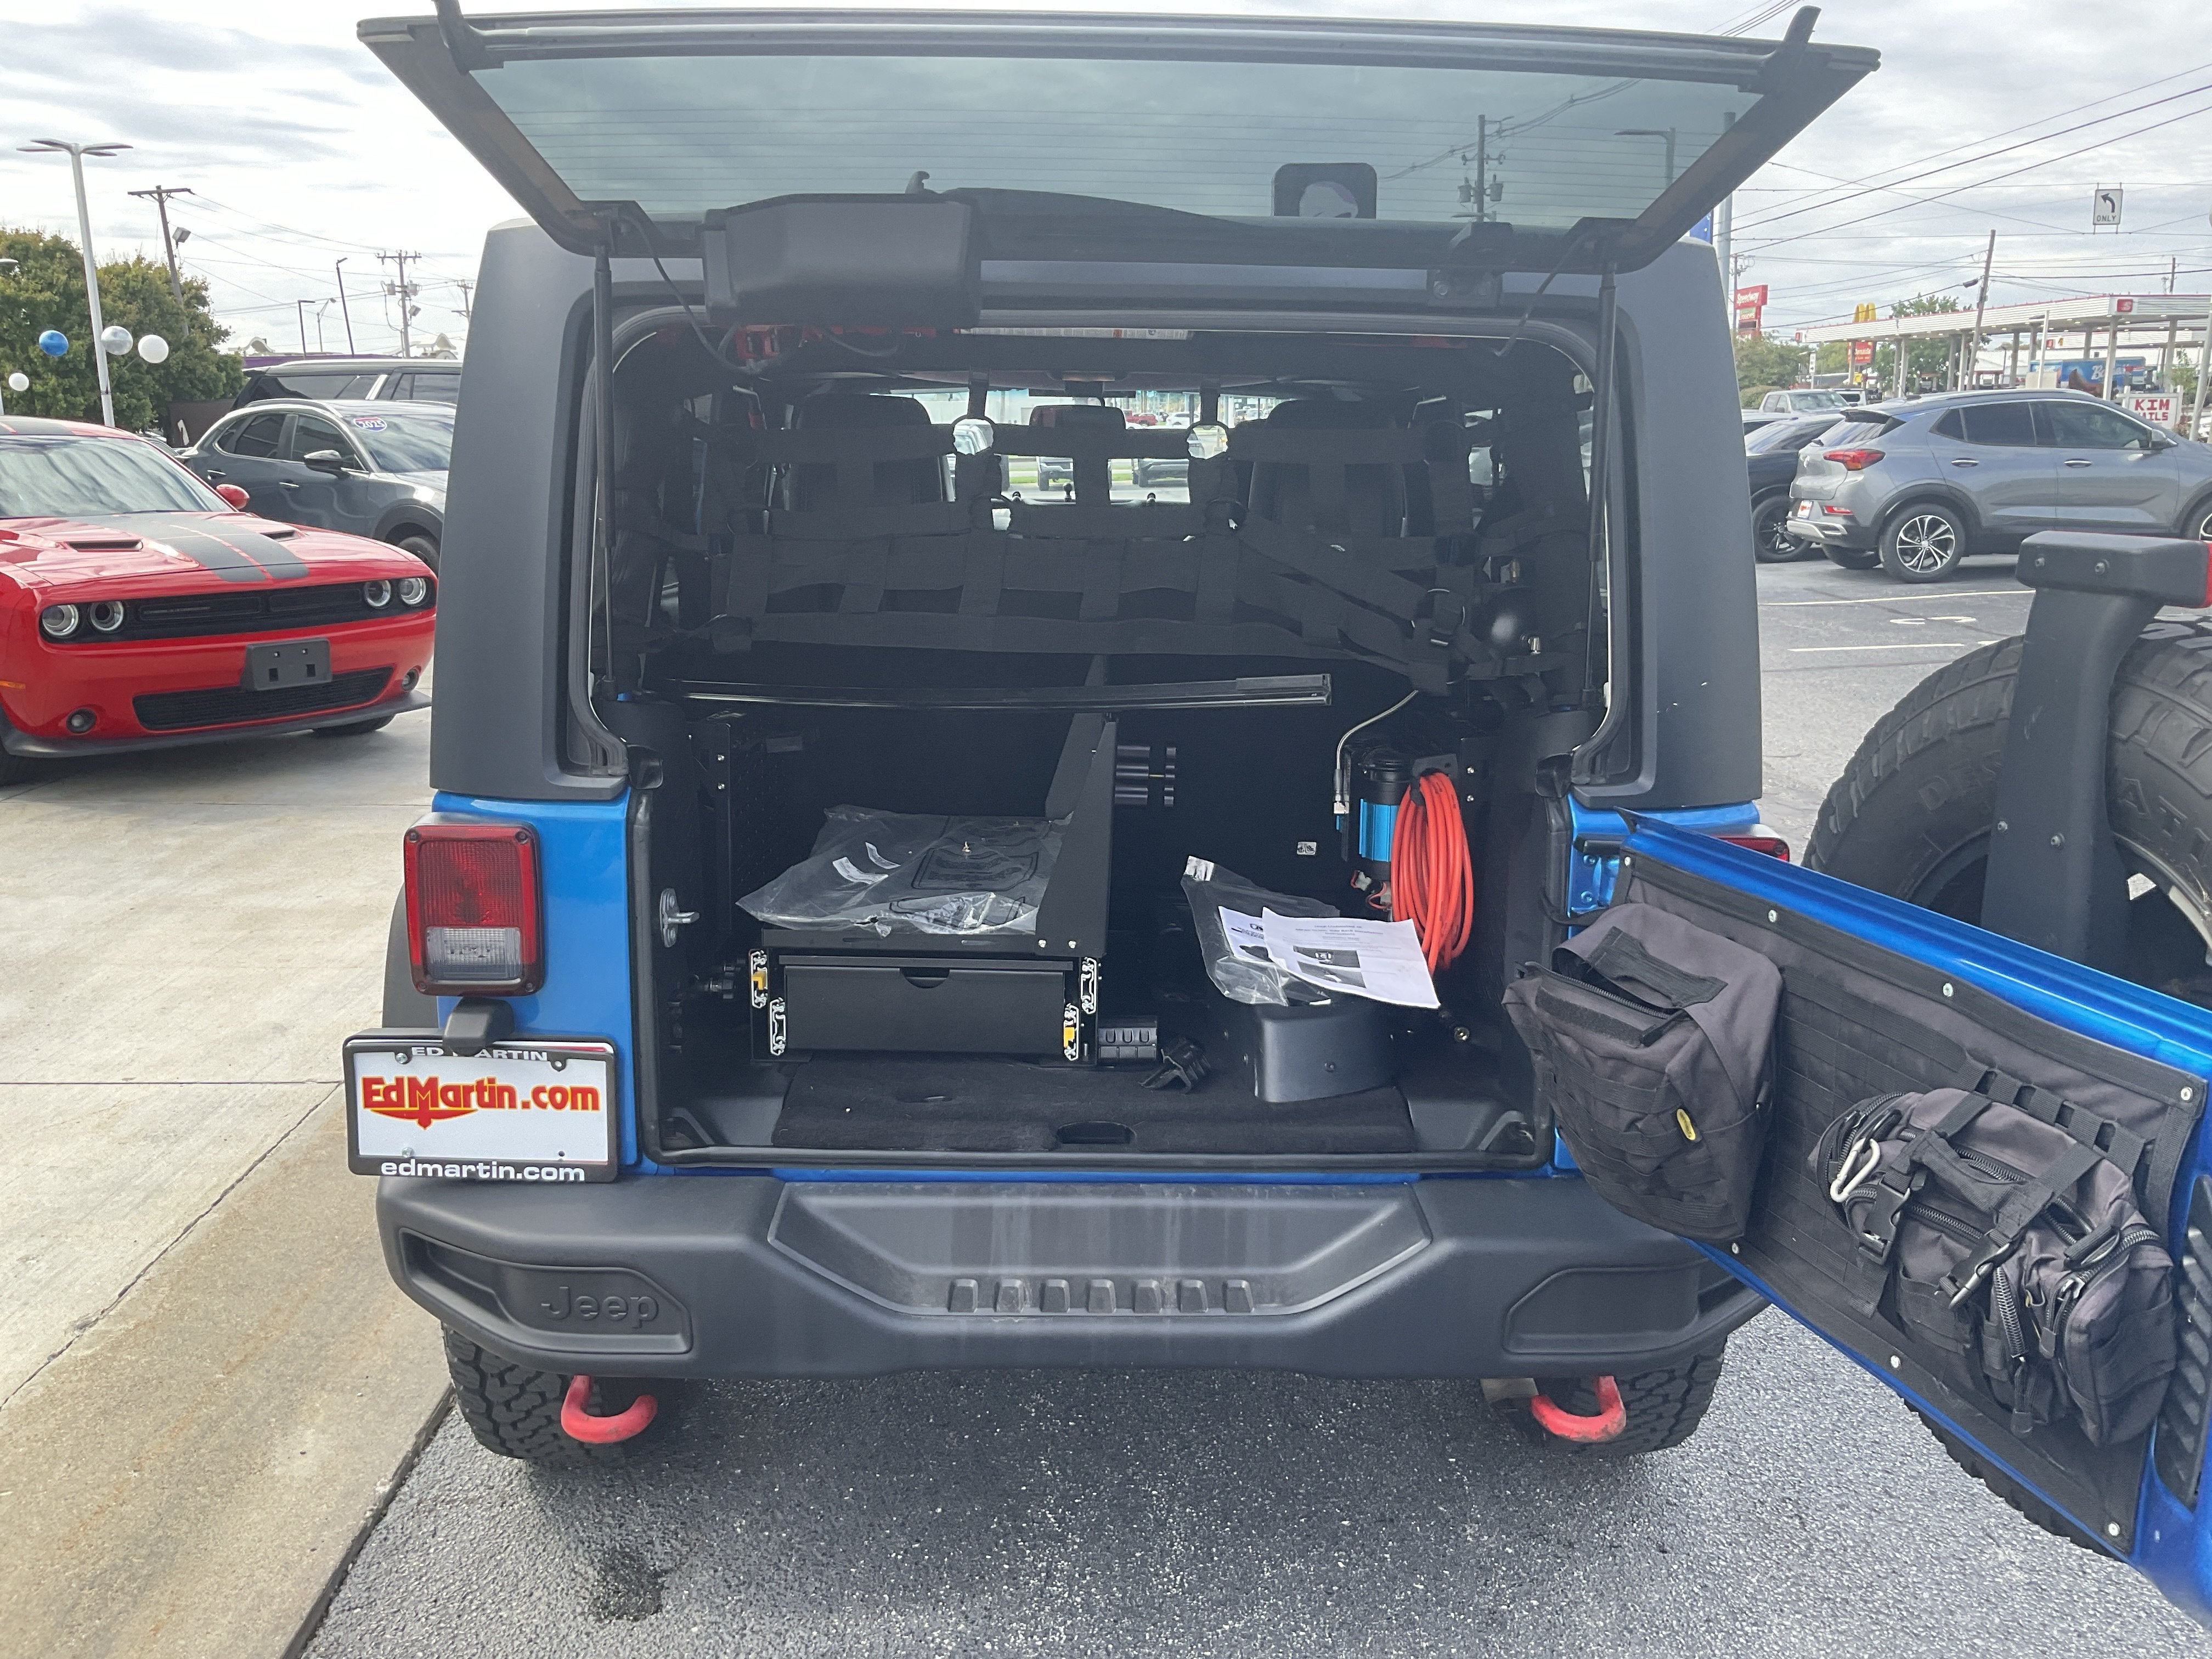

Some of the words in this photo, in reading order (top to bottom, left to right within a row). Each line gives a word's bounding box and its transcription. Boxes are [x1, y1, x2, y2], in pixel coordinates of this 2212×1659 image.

[2135, 399, 2170, 410] KIM
[411, 1046, 444, 1057] ED
[452, 1048, 548, 1062] ARTIN
[361, 1075, 601, 1113] EdMartin.com
[381, 1159, 585, 1182] edmartin.com
[540, 1285, 659, 1329] Jeep
